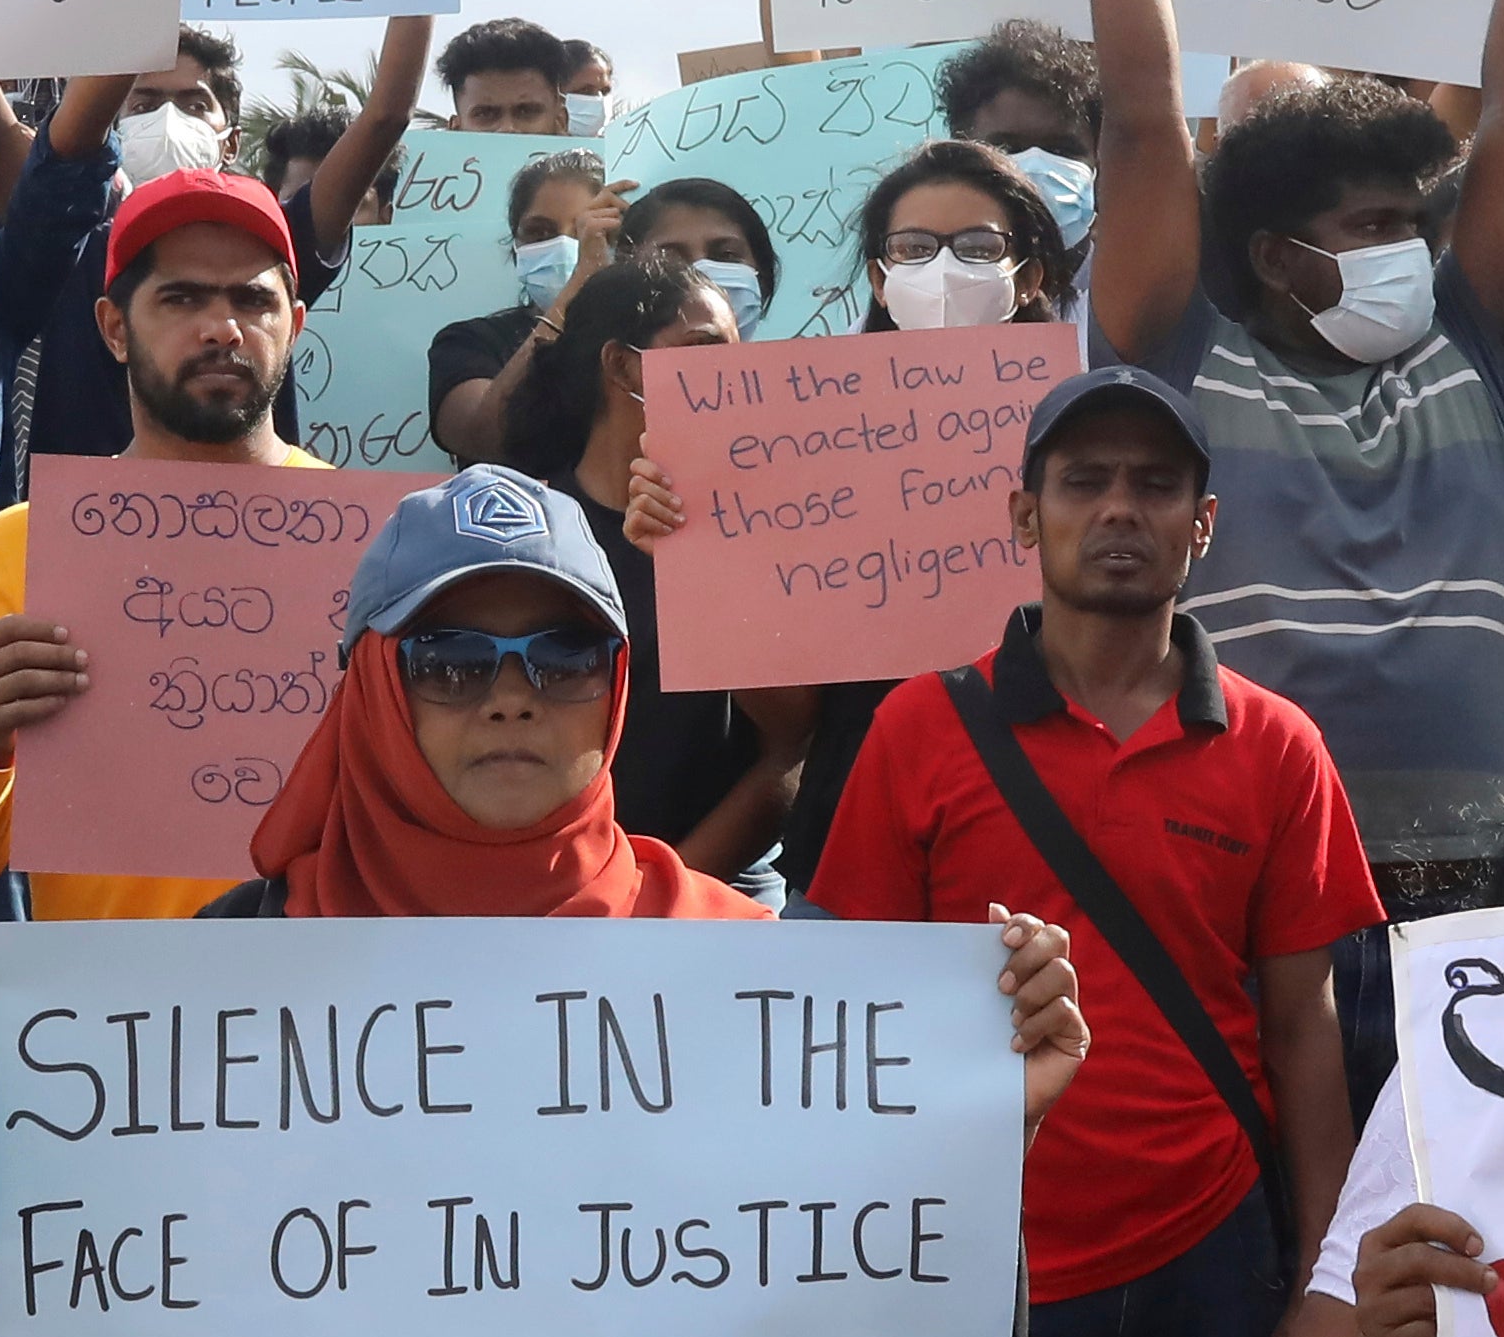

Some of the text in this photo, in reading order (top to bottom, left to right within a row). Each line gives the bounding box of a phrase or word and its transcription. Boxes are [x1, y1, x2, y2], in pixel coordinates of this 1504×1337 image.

[678, 349, 1050, 413] Will the law be
[729, 399, 1036, 470] enacted agai
[711, 486, 857, 539] those
[5, 989, 919, 1142] SILENCE IN THE
[16, 1199, 202, 1317] FACE
[270, 1199, 379, 1301] OF
